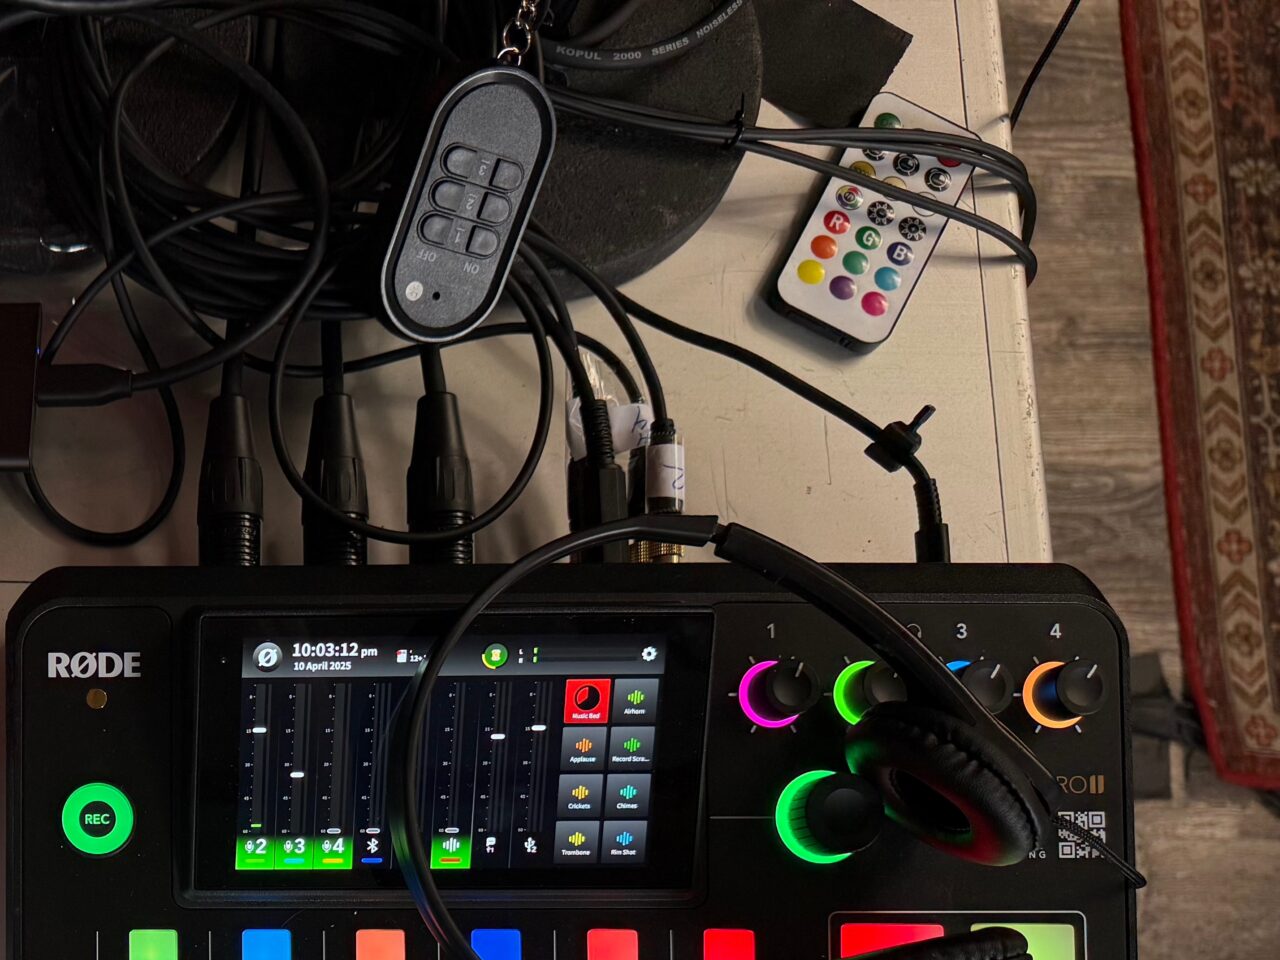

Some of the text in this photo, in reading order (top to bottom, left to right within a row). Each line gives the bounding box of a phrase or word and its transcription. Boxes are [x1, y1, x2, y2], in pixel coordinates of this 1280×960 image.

[556, 45, 602, 60] KOPUL
[613, 51, 641, 60] 2000
[651, 37, 689, 56] SERIES
[830, 215, 844, 231] R
[863, 231, 874, 246] G
[892, 244, 907, 261] B
[767, 623, 776, 639] 1
[956, 623, 967, 640] 3
[1049, 623, 1062, 639] 4
[292, 642, 378, 659] 10:03:12 pm
[47, 651, 142, 679] RØDE
[294, 662, 352, 672] 10 April 2025
[570, 756, 596, 764] Applause
[1056, 775, 1088, 794] RO
[84, 813, 111, 826] REC
[255, 838, 267, 854] 2
[294, 838, 305, 854] 3
[332, 837, 345, 854] 4
